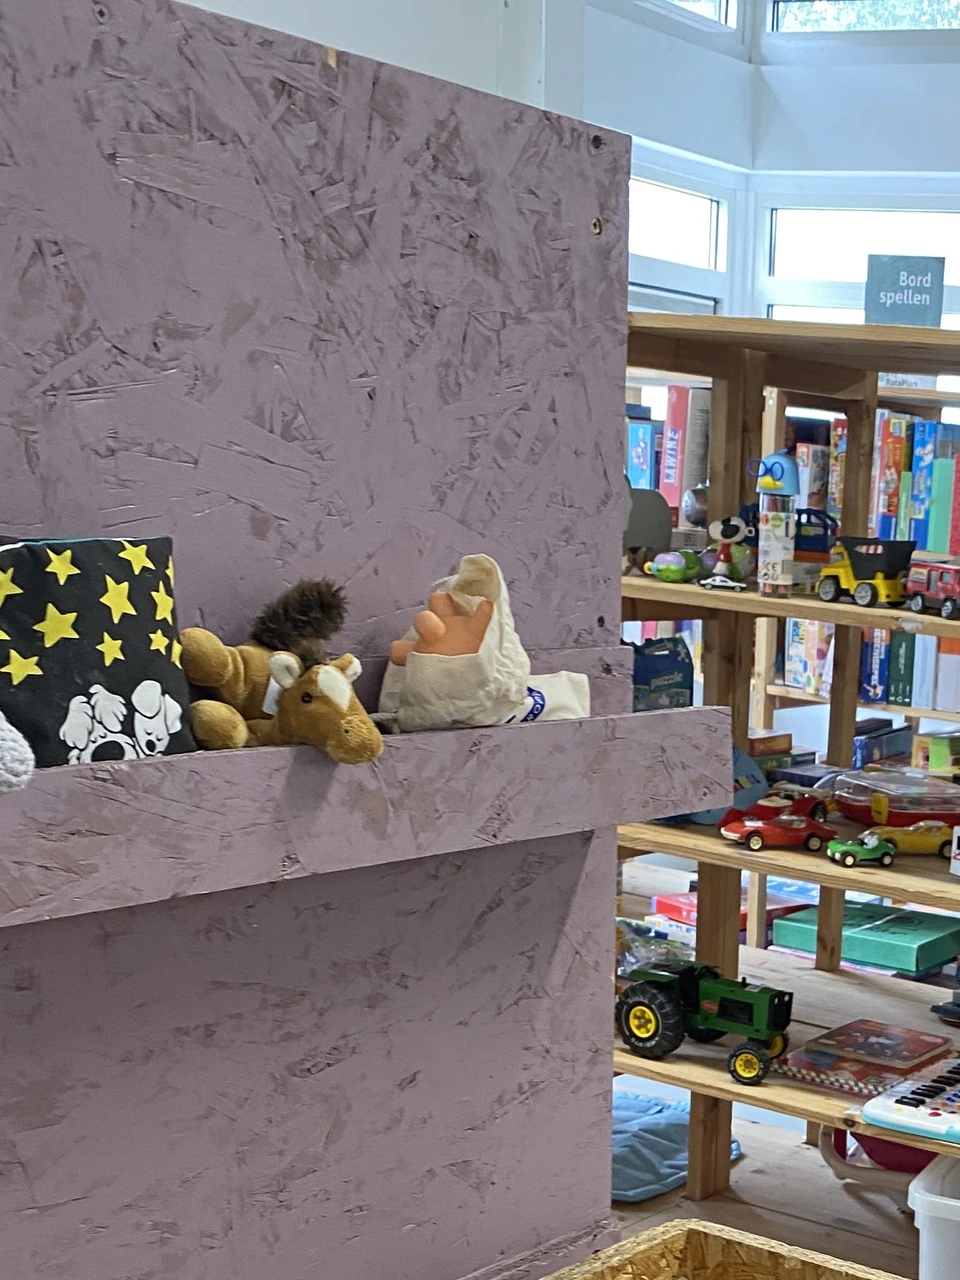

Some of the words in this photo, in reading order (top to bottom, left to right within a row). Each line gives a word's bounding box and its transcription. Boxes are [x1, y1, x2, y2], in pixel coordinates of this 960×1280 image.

[900, 271, 931, 287] Bord
[879, 290, 930, 307] spellen
[664, 429, 679, 483] LAWINE
